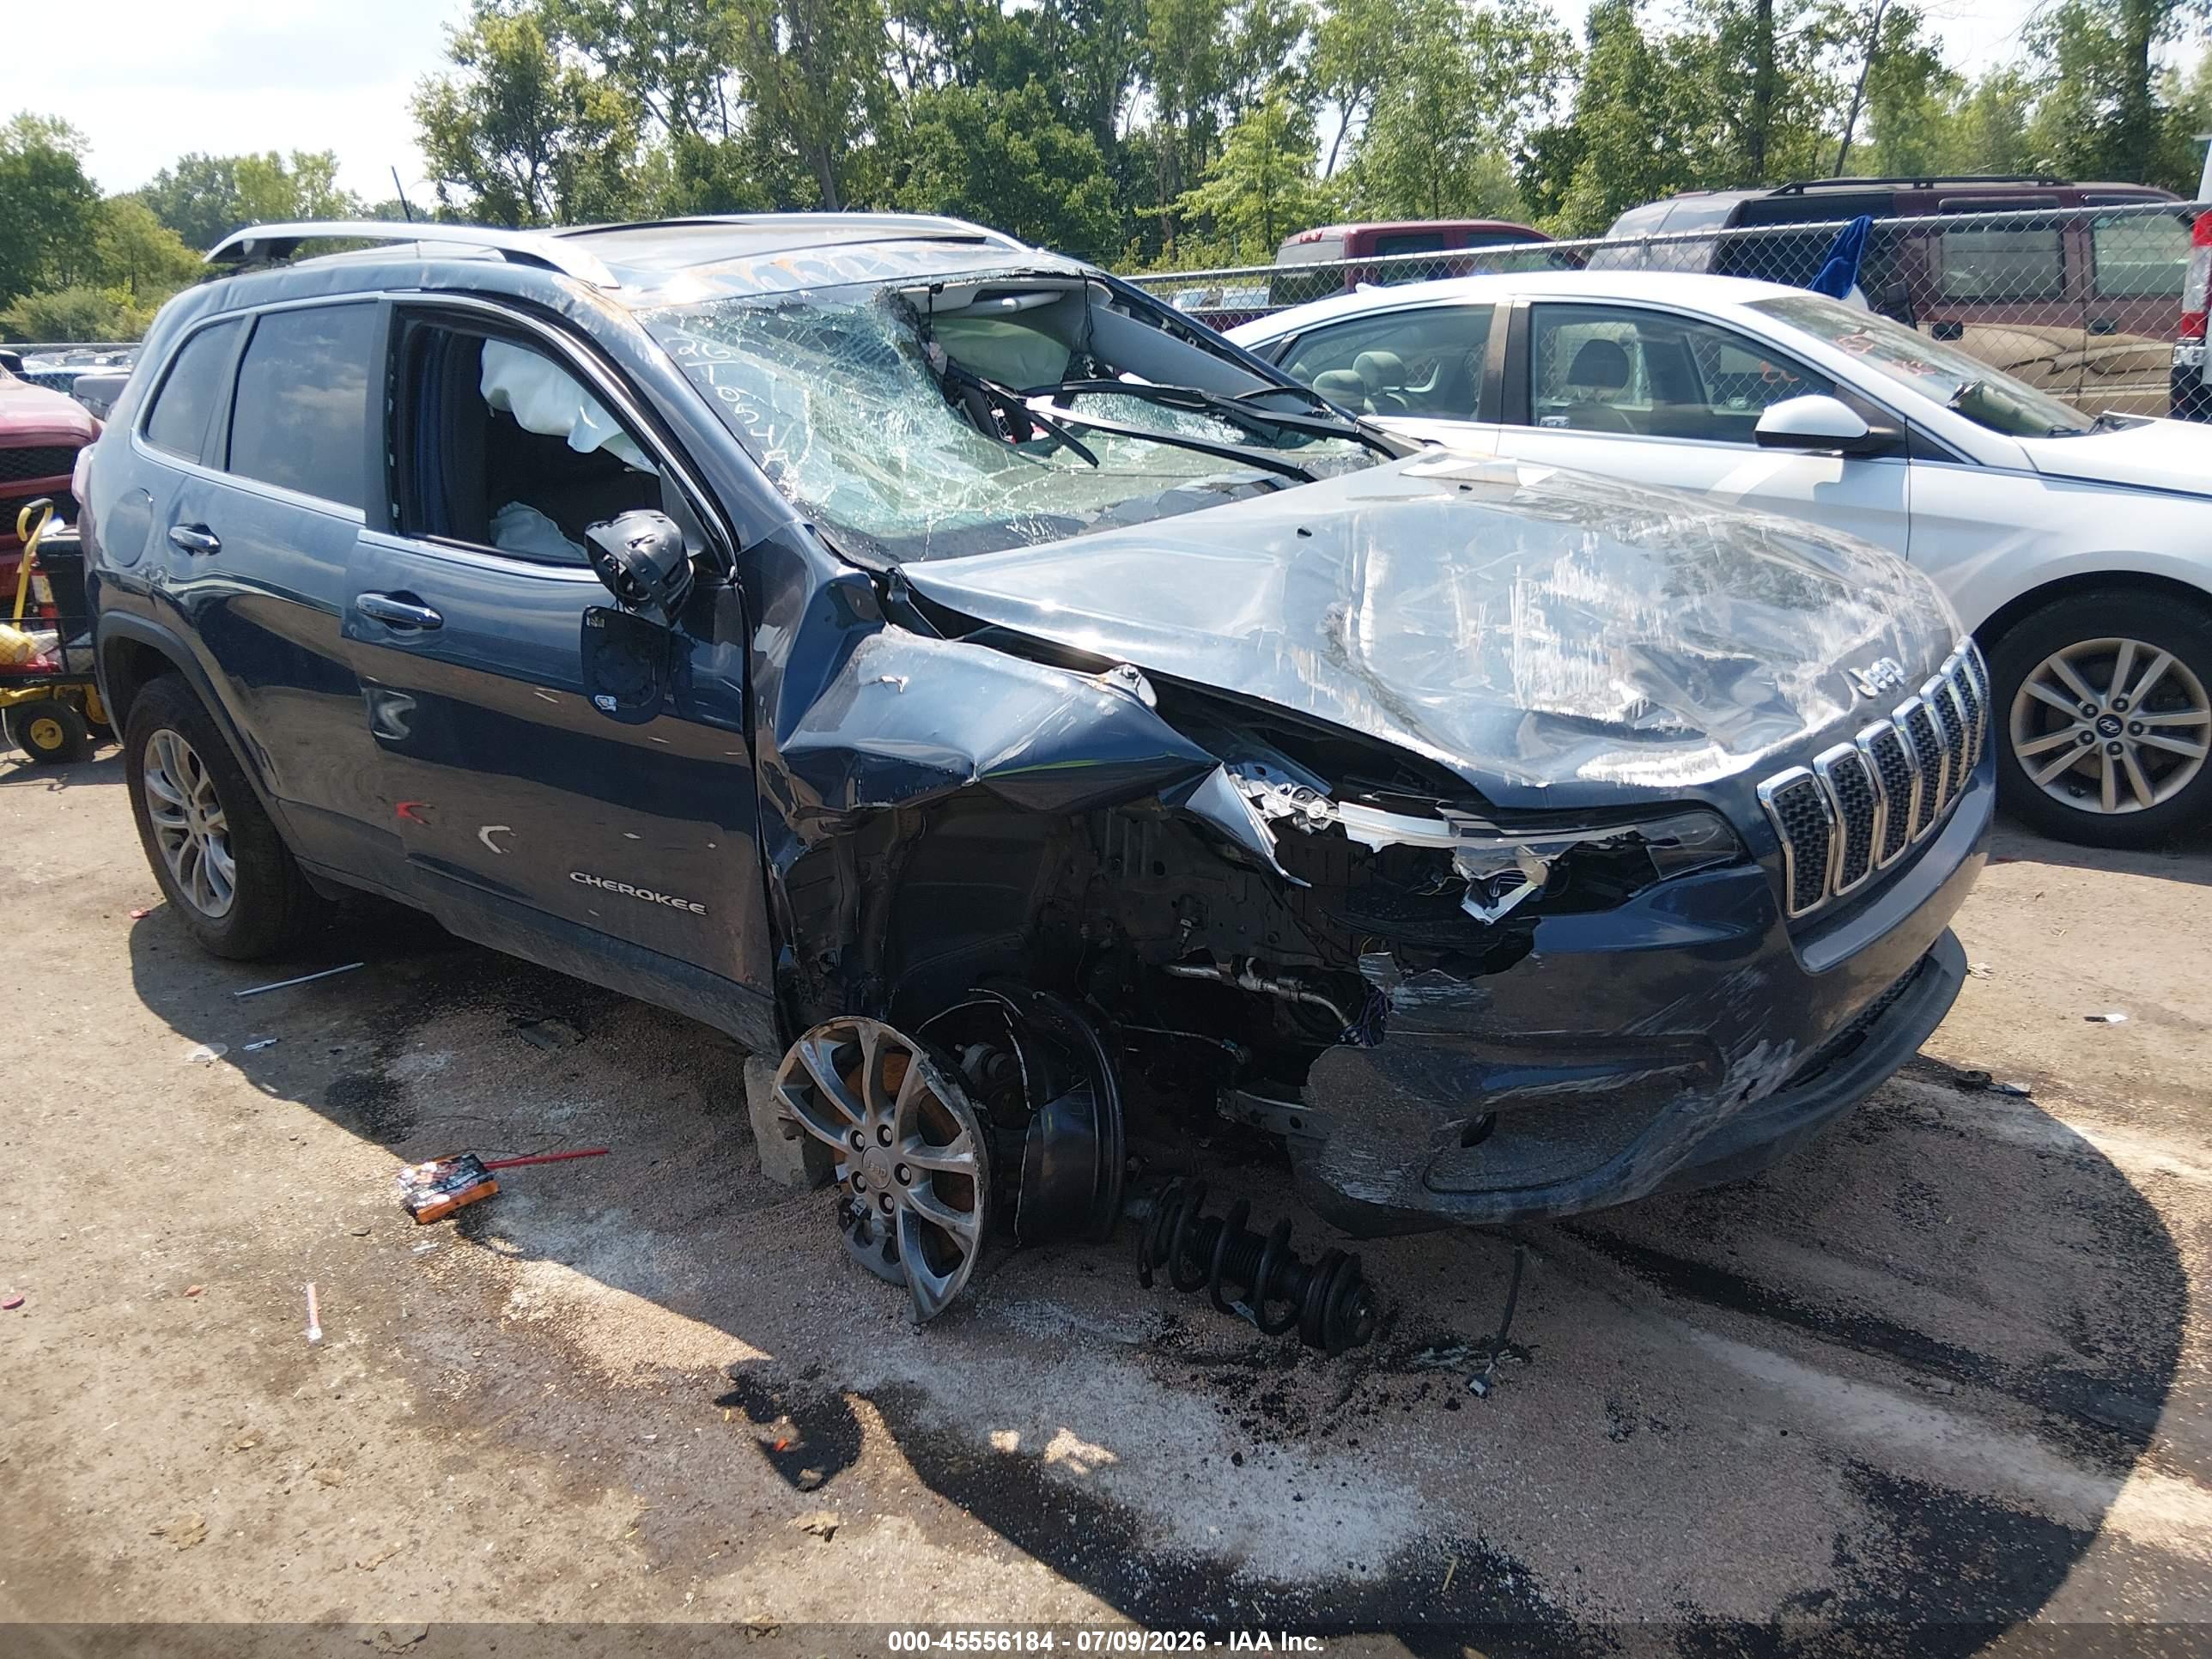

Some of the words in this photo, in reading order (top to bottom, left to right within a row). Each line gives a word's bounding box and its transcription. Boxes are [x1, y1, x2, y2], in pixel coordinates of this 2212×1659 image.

[1848, 657, 1905, 697] Jeep
[569, 871, 708, 916] CHEROKEE
[866, 1160, 888, 1178] Jeep
